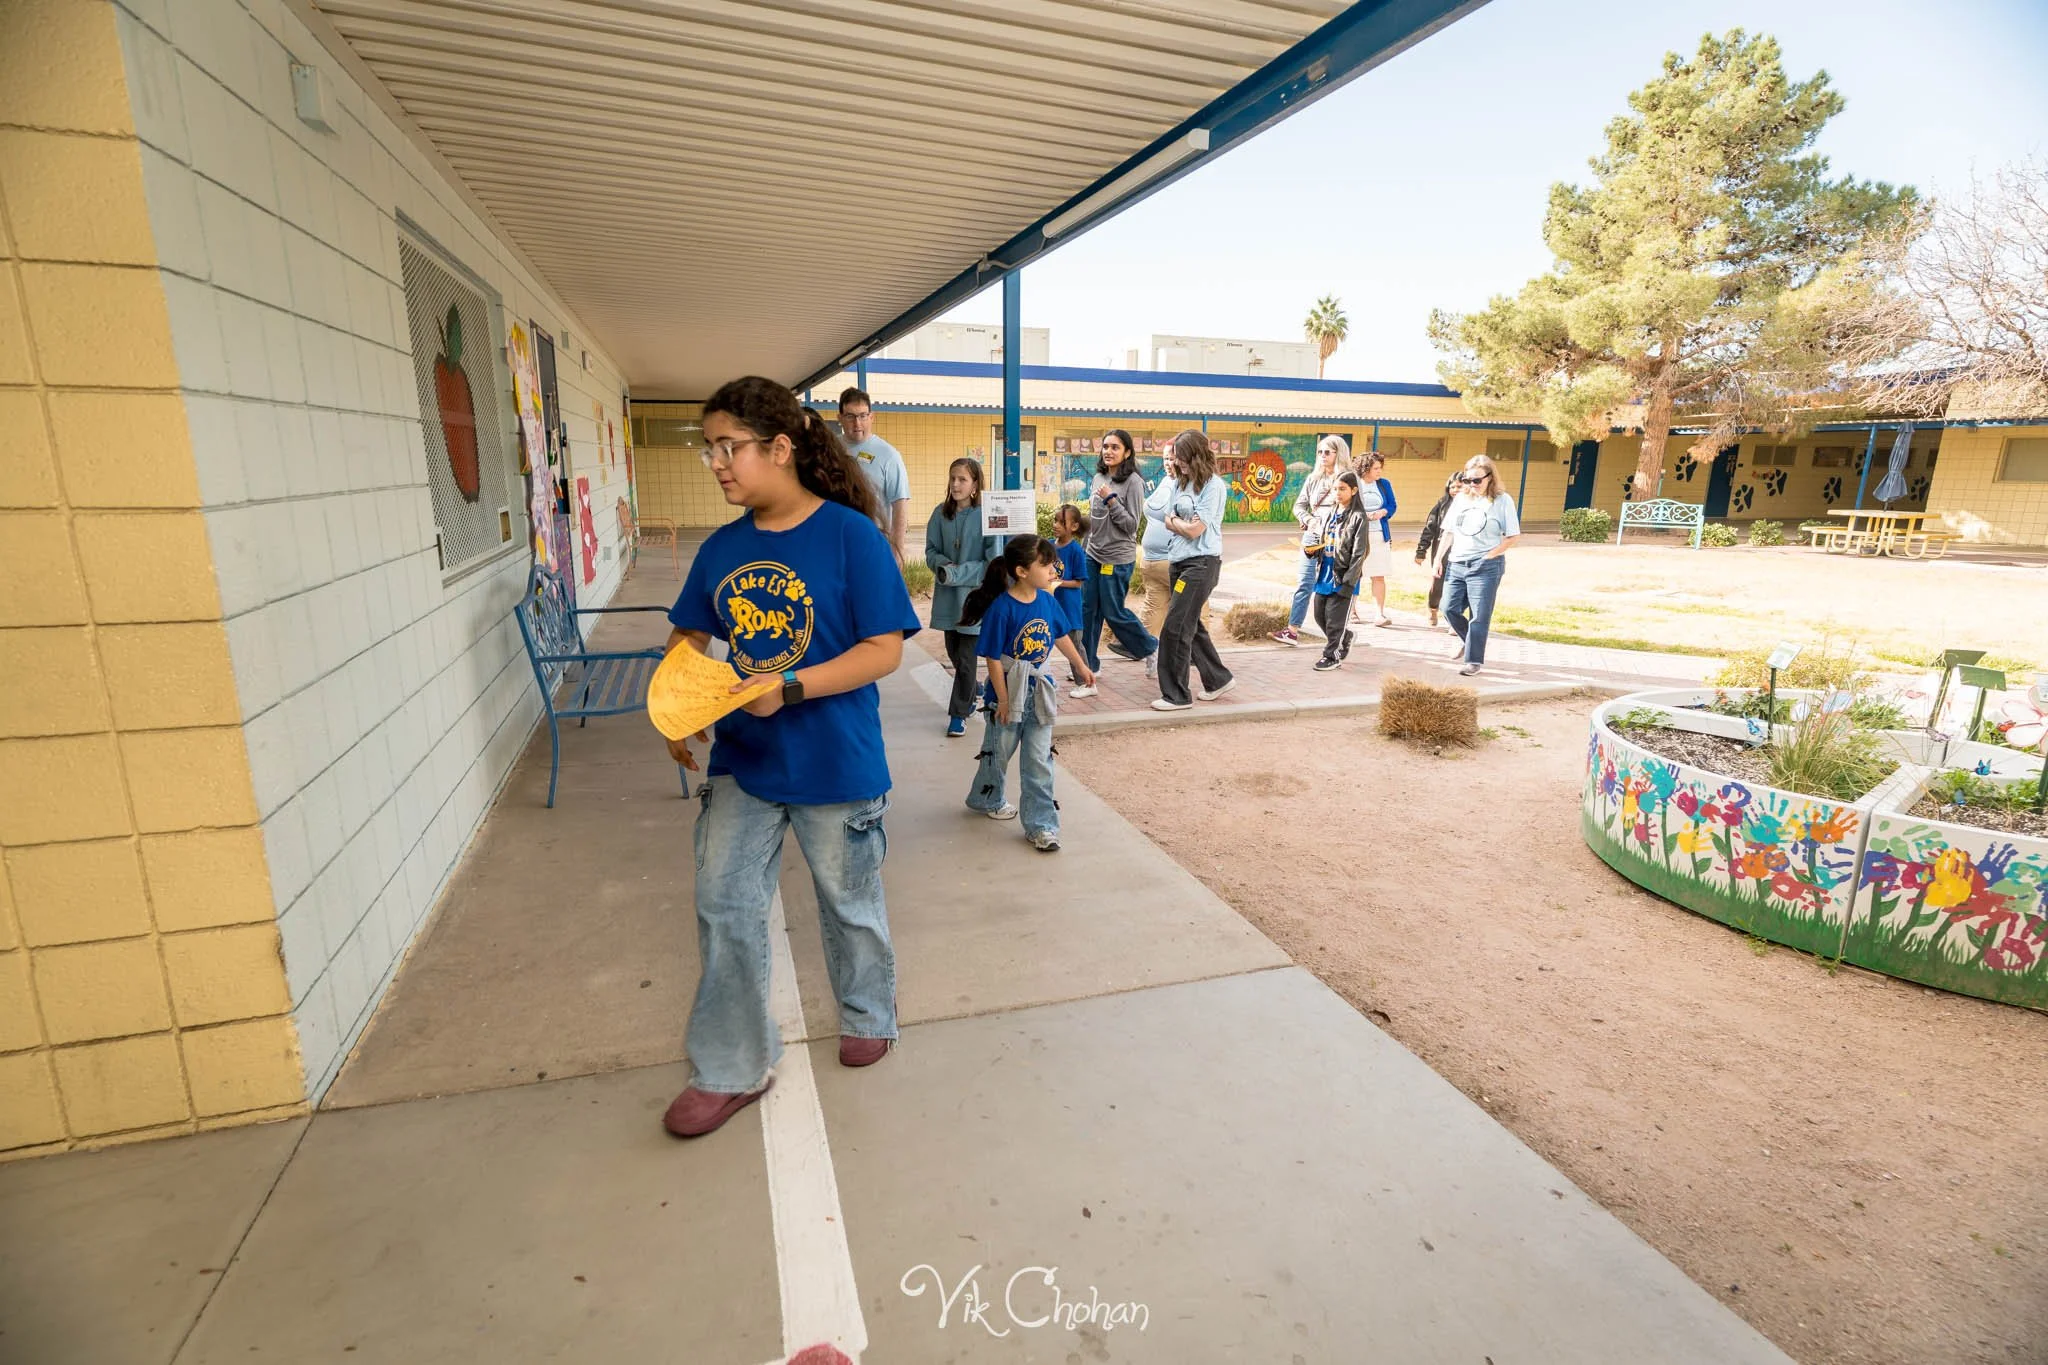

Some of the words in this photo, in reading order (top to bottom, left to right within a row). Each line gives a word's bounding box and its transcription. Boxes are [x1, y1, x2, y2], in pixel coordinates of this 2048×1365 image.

[731, 572, 766, 596] Lake
[766, 573, 787, 596] ES
[737, 602, 790, 635] ROAR
